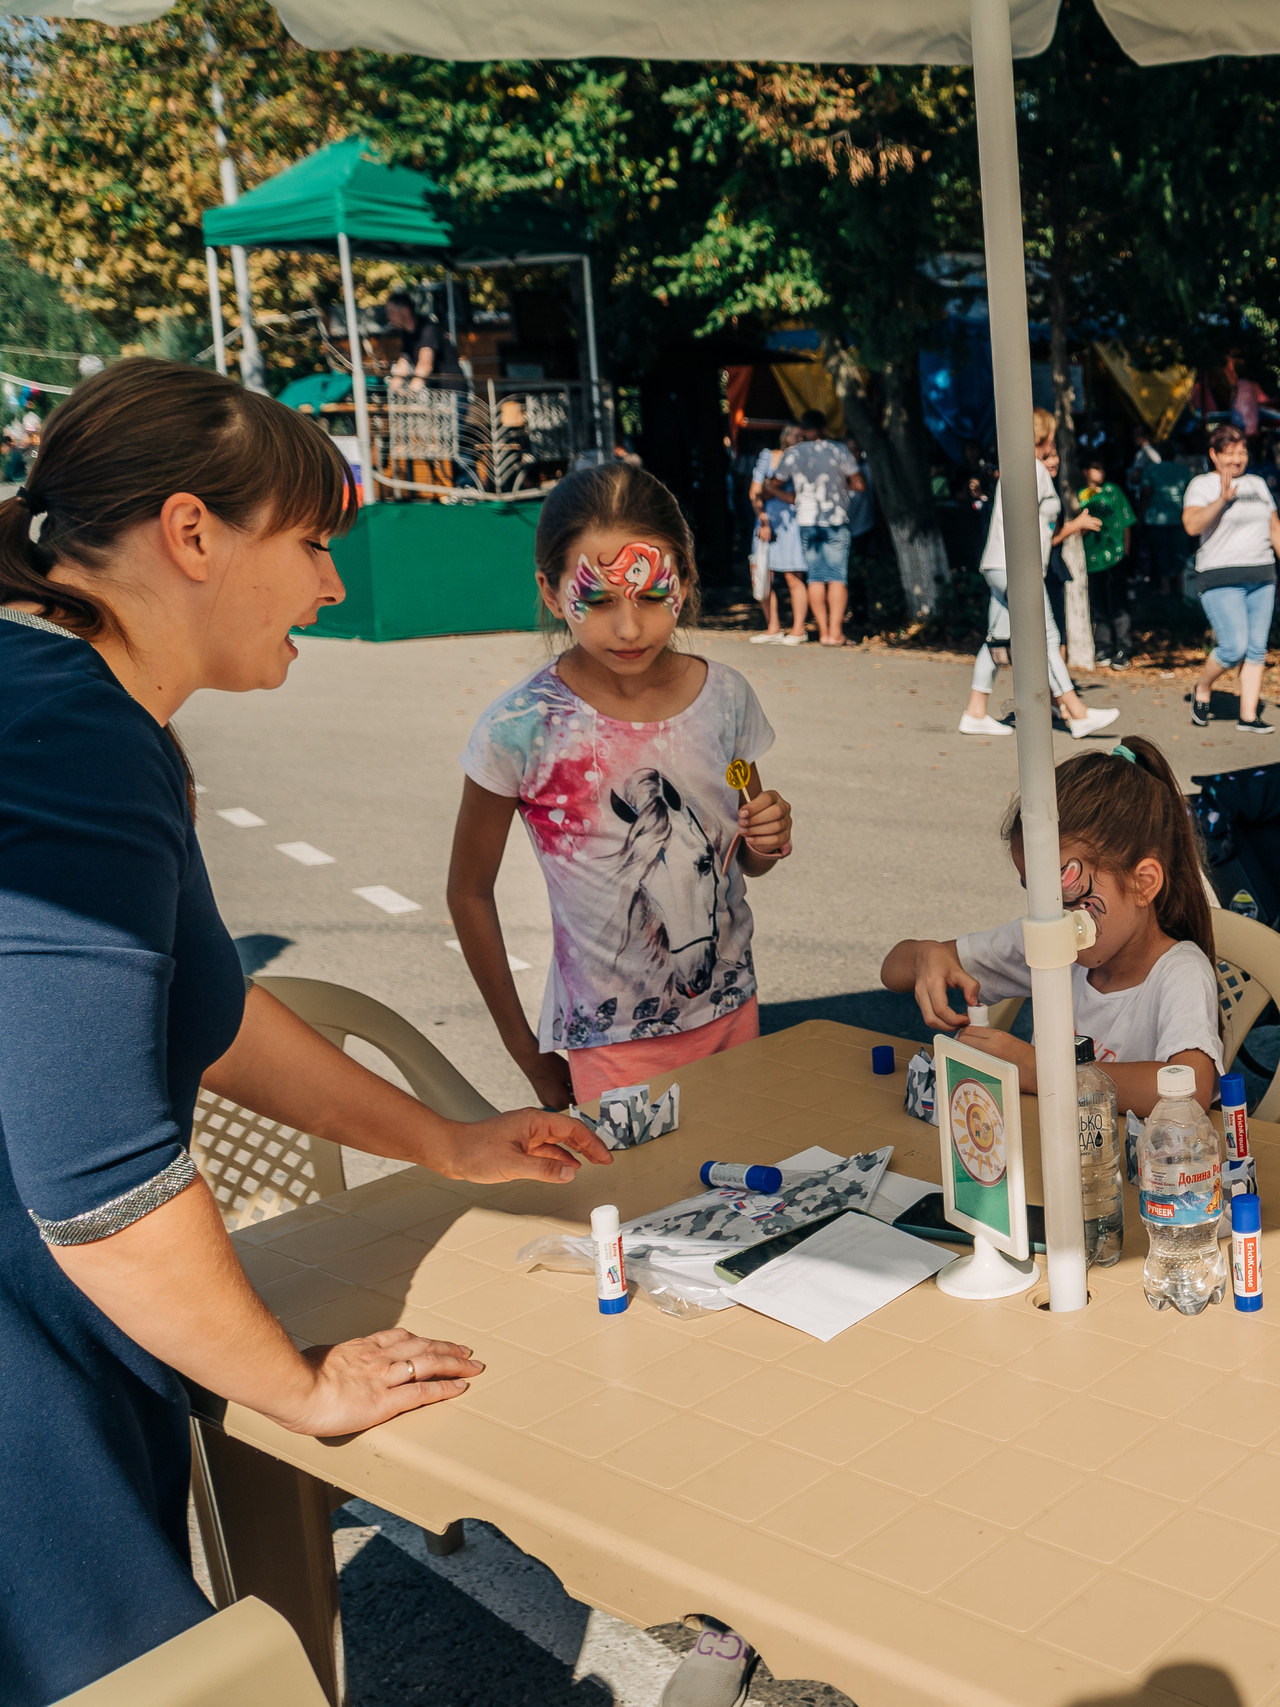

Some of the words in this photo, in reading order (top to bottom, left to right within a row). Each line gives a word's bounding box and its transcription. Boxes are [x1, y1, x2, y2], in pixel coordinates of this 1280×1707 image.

[1080, 1113, 1103, 1132] ЬКО
[1079, 1131, 1096, 1151] ДА
[1178, 1169, 1211, 1188] Долина
[1246, 1242, 1255, 1288] ErichKrause
